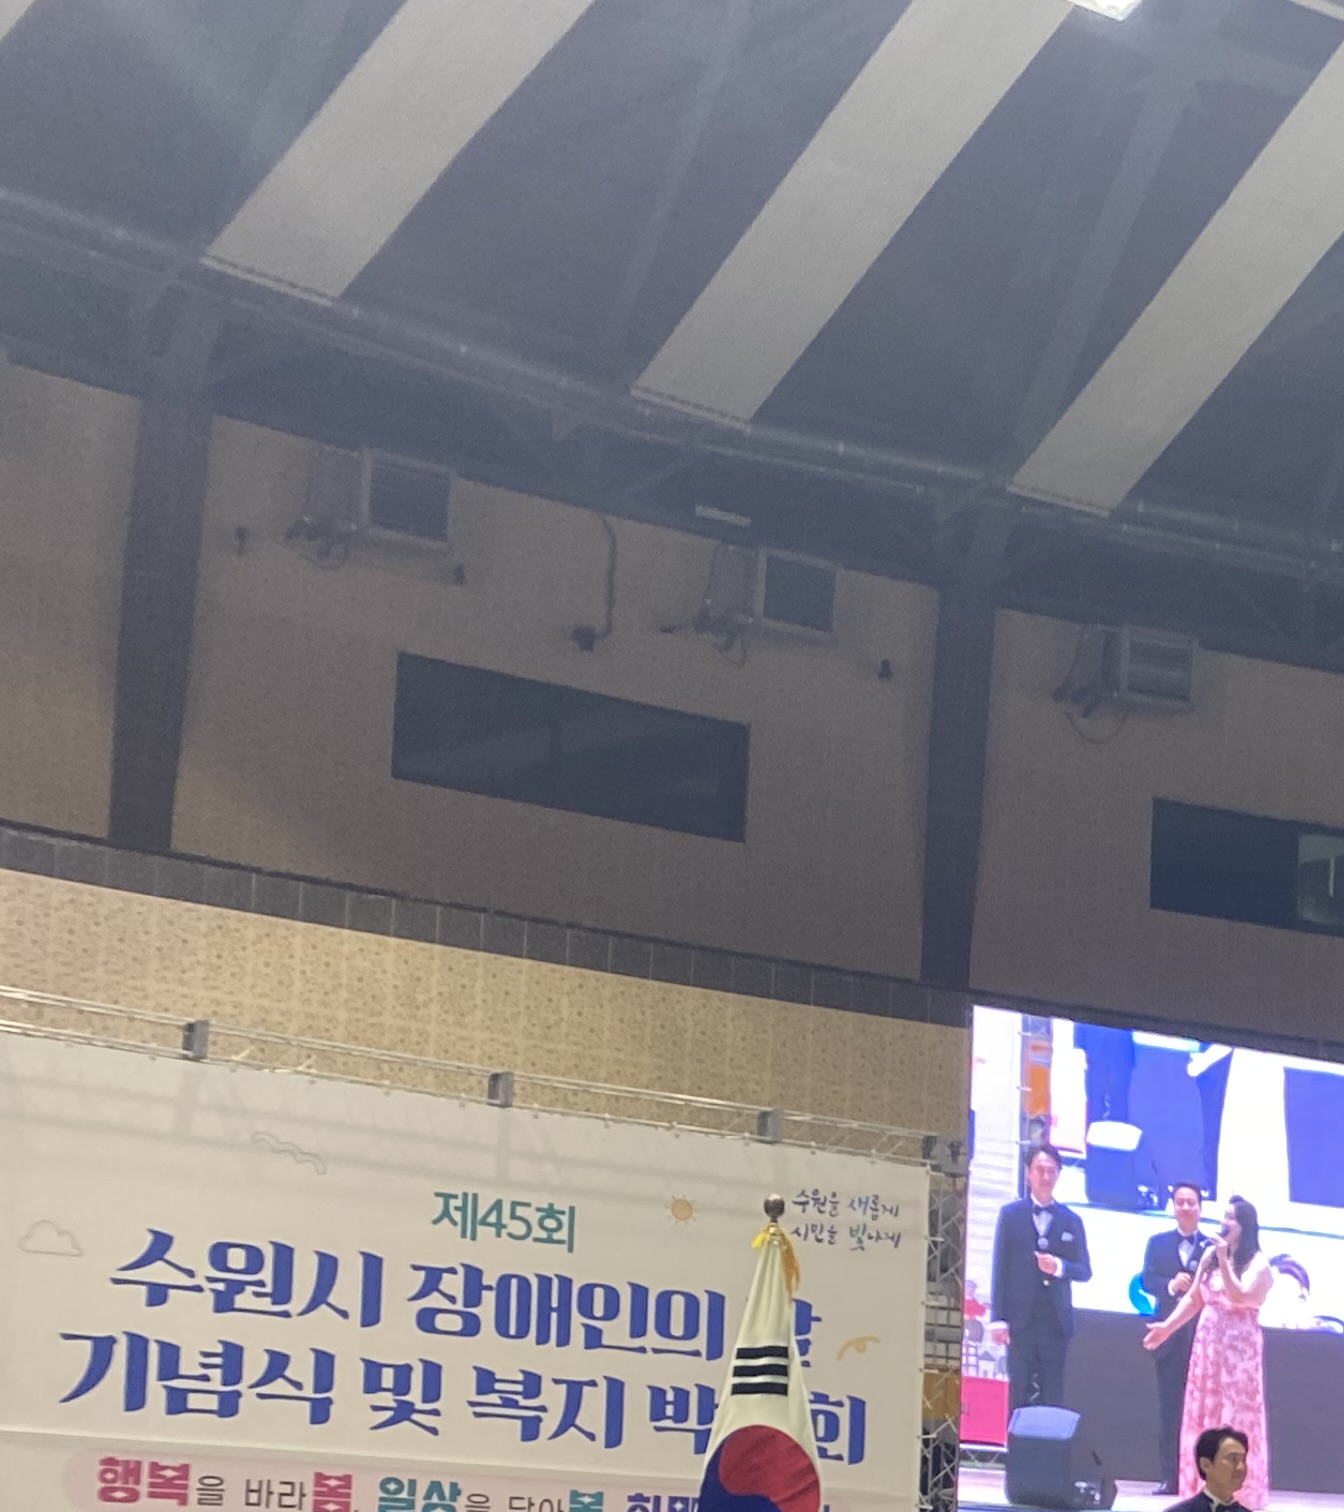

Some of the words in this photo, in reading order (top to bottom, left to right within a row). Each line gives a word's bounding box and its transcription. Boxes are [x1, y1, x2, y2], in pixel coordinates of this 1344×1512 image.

[431, 1191, 576, 1253] 제45회
[109, 1228, 384, 1329] 수원시
[406, 1262, 727, 1362] 장애인의
[58, 1330, 336, 1426] 기념식
[359, 1357, 443, 1437] 및
[467, 1365, 626, 1450] 복지
[646, 1383, 867, 1466] 박회
[97, 1456, 226, 1508] 행복을
